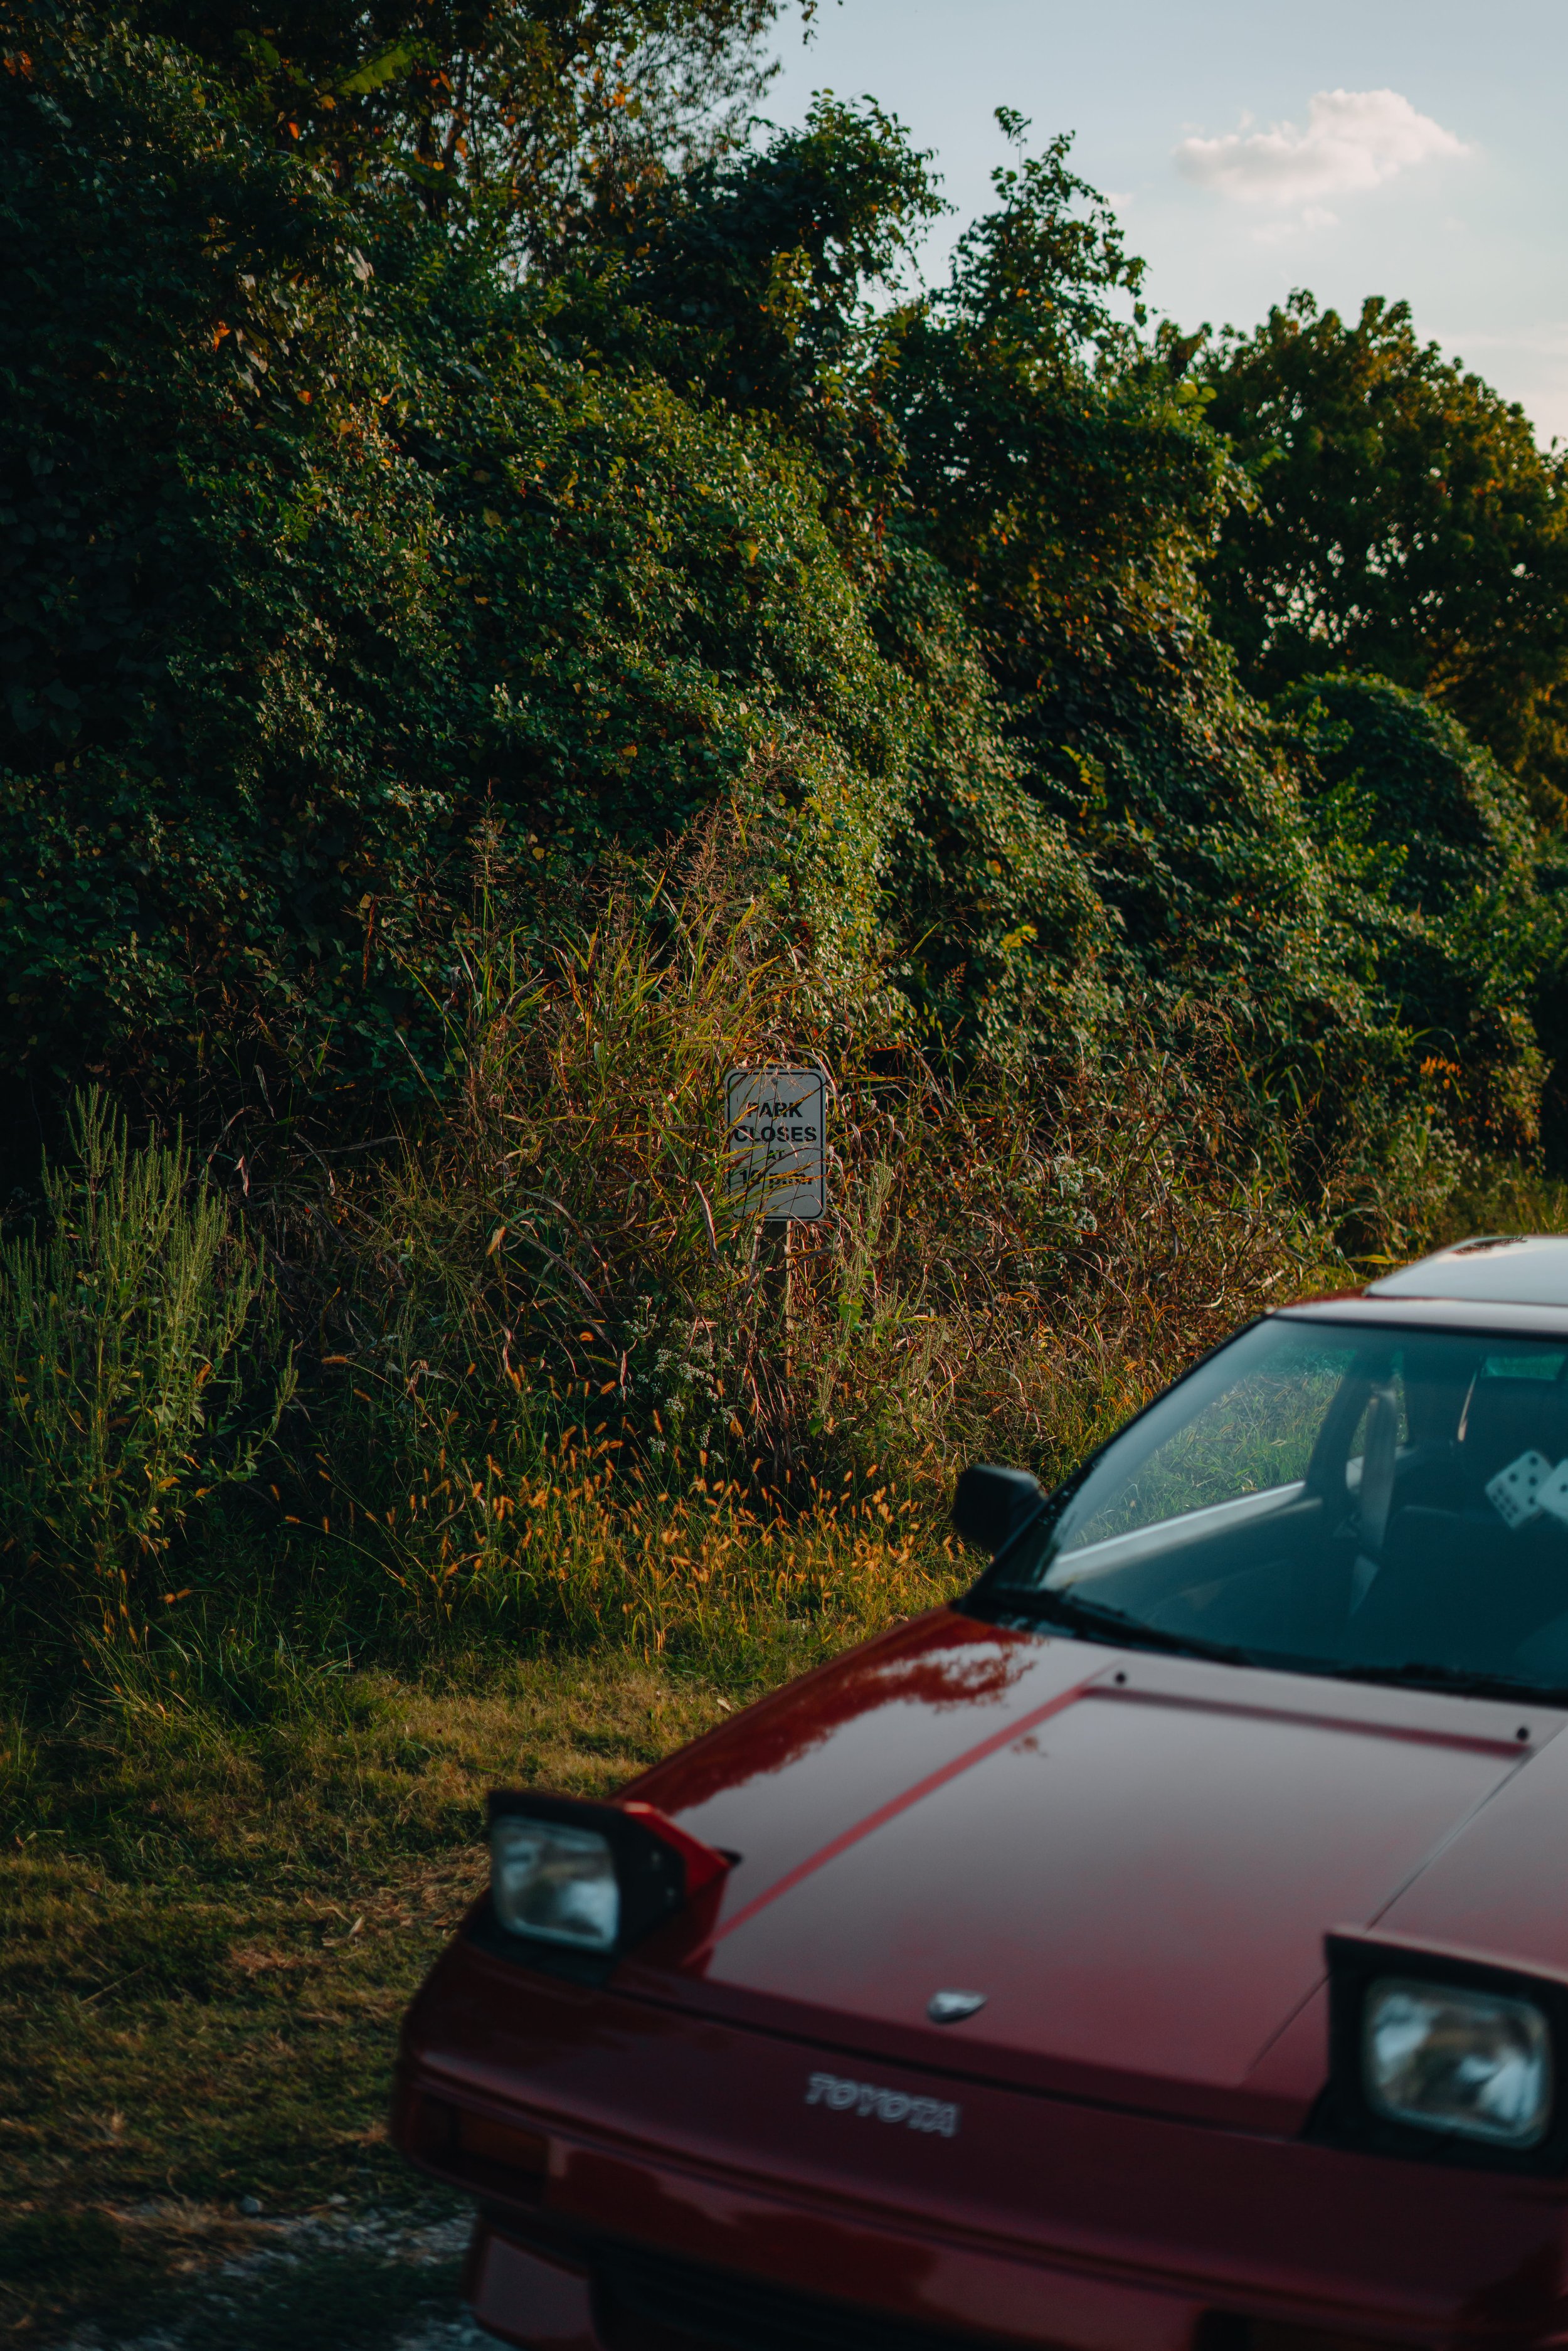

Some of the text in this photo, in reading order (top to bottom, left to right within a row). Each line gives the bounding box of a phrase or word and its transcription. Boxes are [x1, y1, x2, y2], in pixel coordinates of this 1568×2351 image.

[747, 1102, 803, 1117] PARK
[734, 1126, 817, 1142] CLOSES
[767, 1150, 784, 1160] AT
[805, 2071, 960, 2137] TOYOTA
